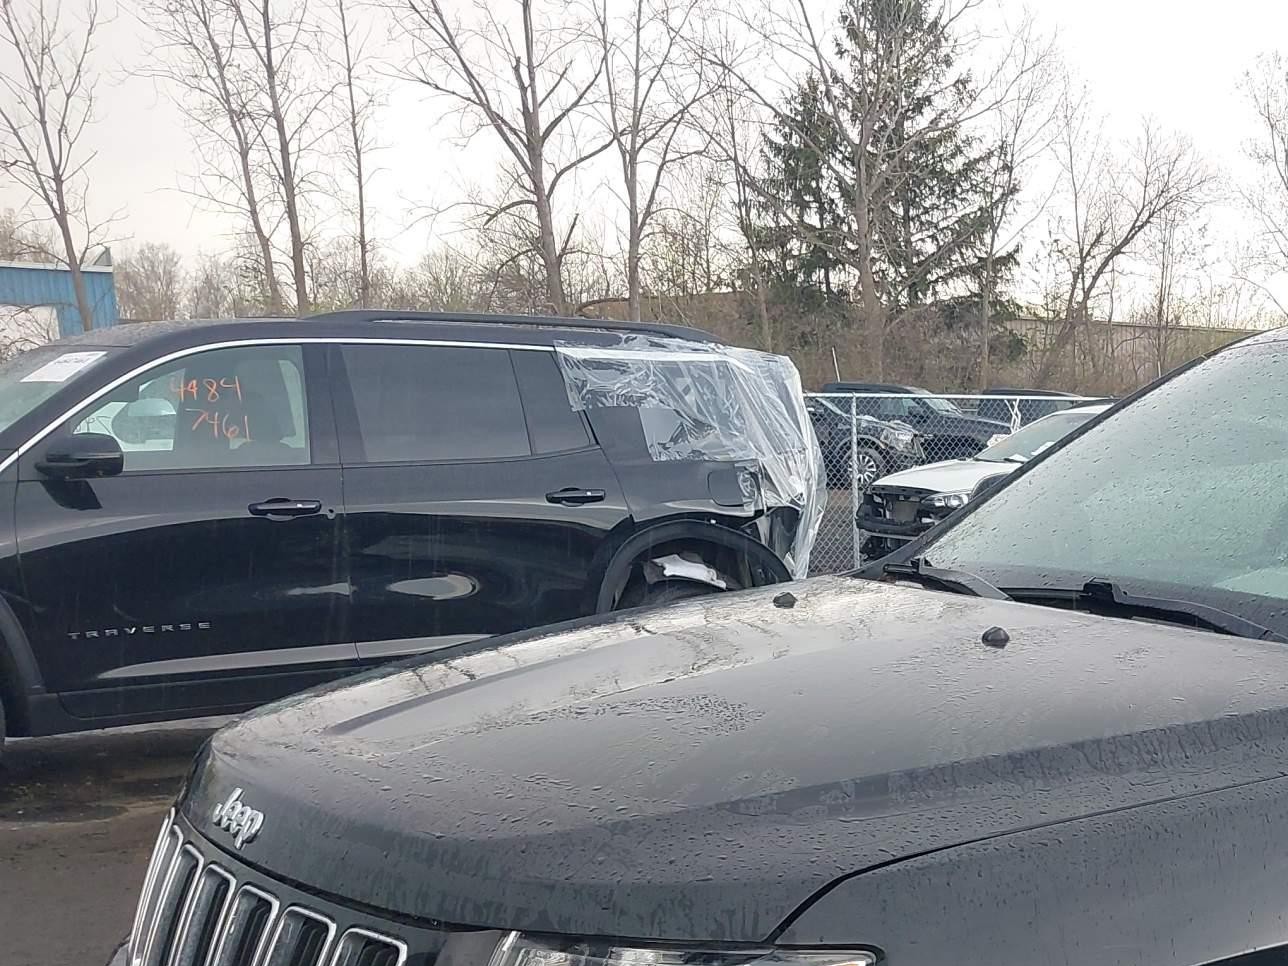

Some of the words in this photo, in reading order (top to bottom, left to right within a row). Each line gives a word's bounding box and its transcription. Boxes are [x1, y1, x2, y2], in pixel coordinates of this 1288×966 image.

[170, 376, 242, 402] 4484
[185, 408, 250, 442] 7461
[68, 622, 211, 640] TRAVERSE
[212, 787, 265, 849] Jeep
